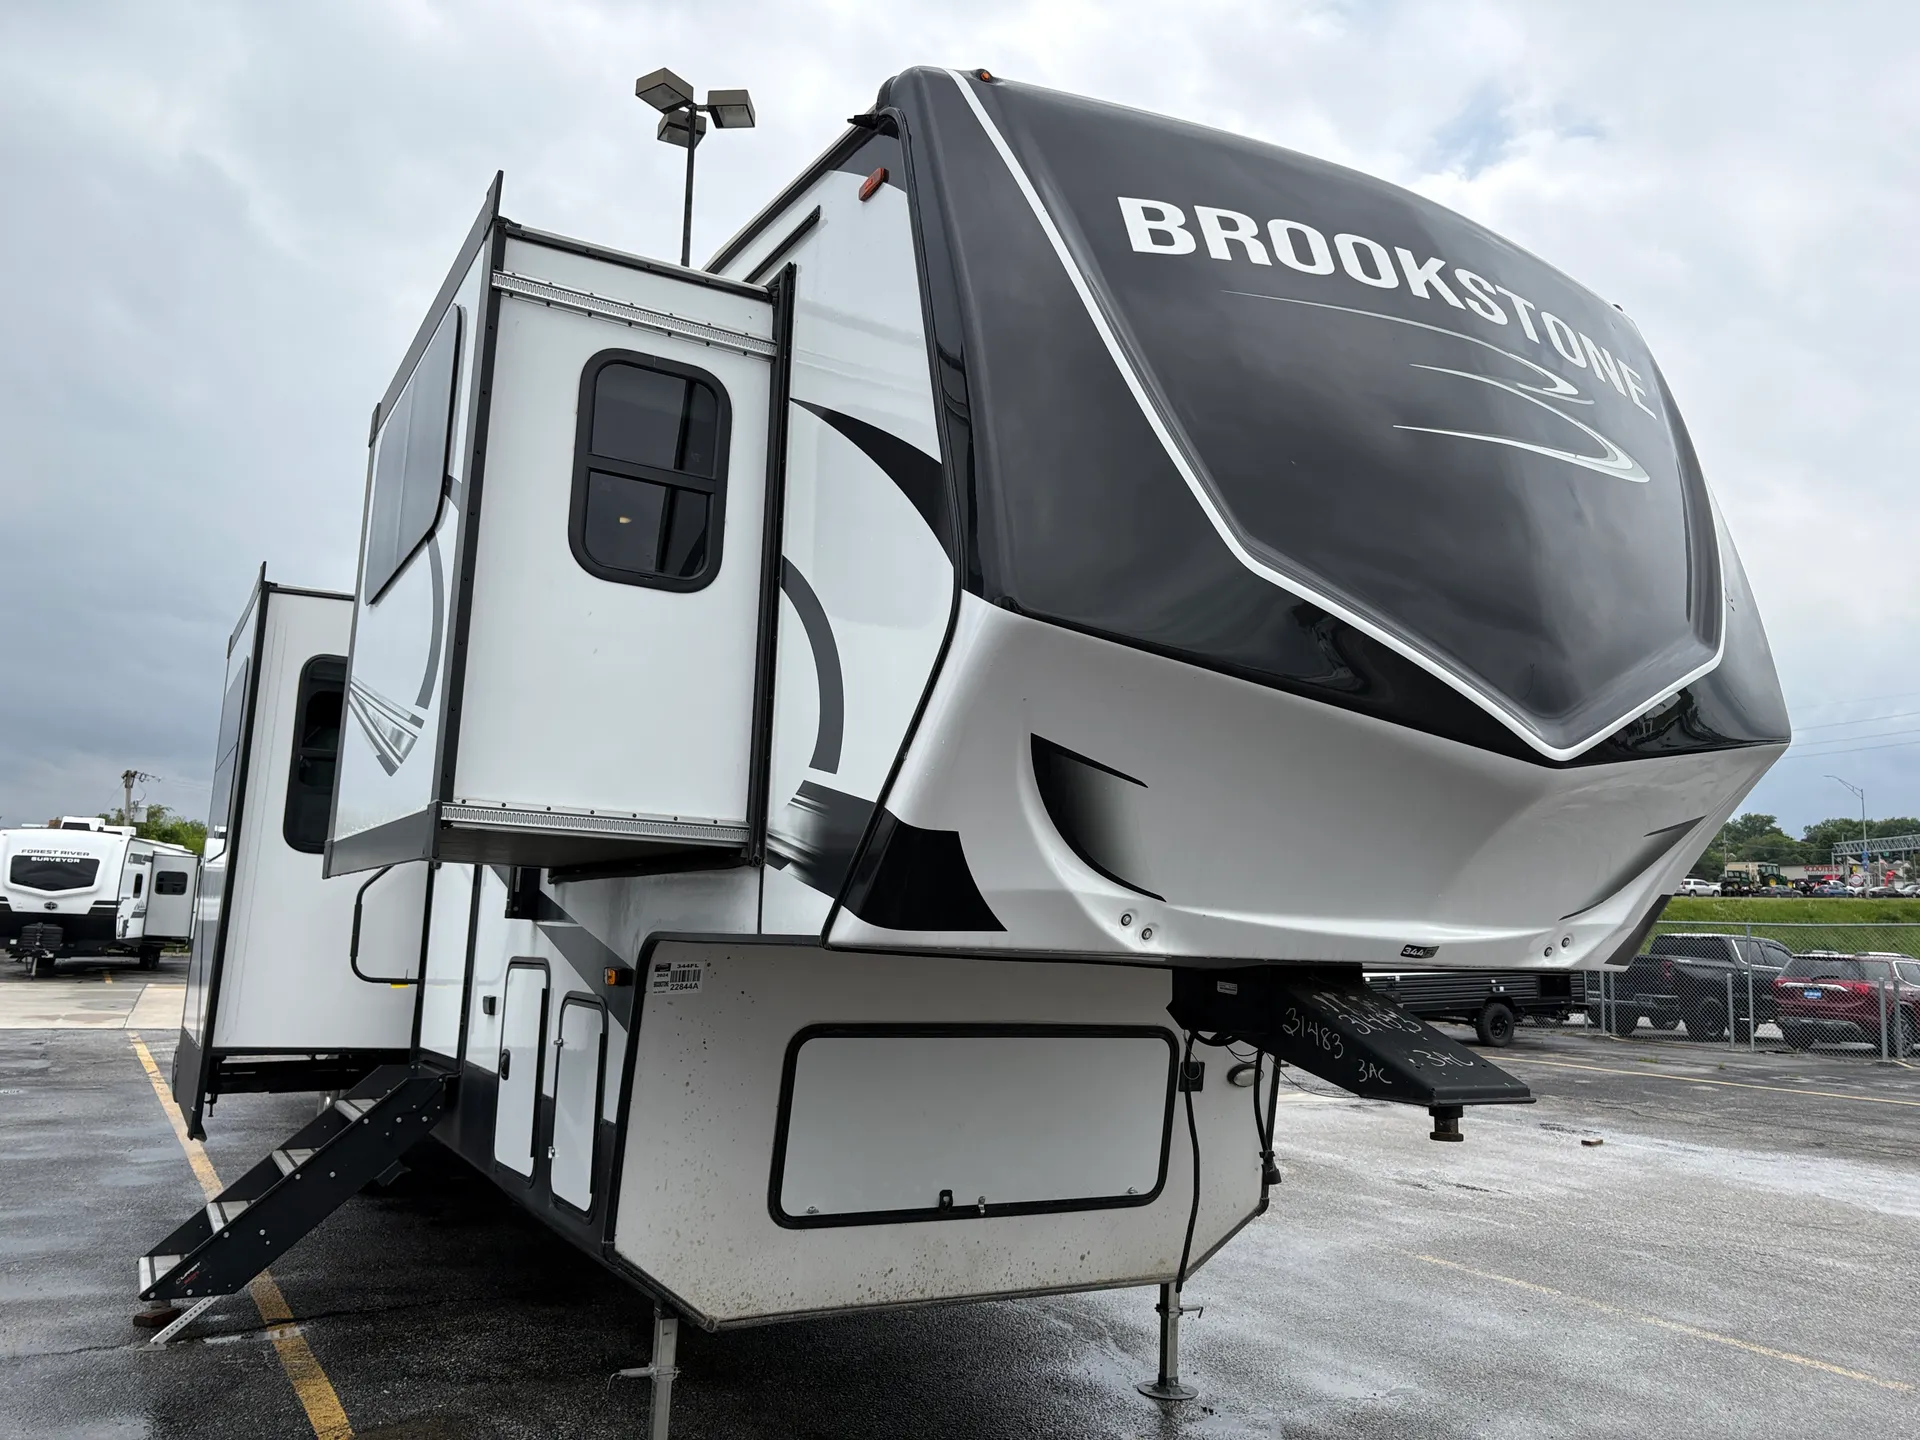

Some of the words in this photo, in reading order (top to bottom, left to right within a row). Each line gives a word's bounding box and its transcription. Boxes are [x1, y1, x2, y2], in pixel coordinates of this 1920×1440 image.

[1117, 196, 1658, 420] BROOKSTONE
[30, 856, 80, 864] SURVEYOR
[669, 982, 699, 991] 22844A
[1282, 1007, 1344, 1059] 31483
[1358, 1059, 1392, 1084] 3AC
